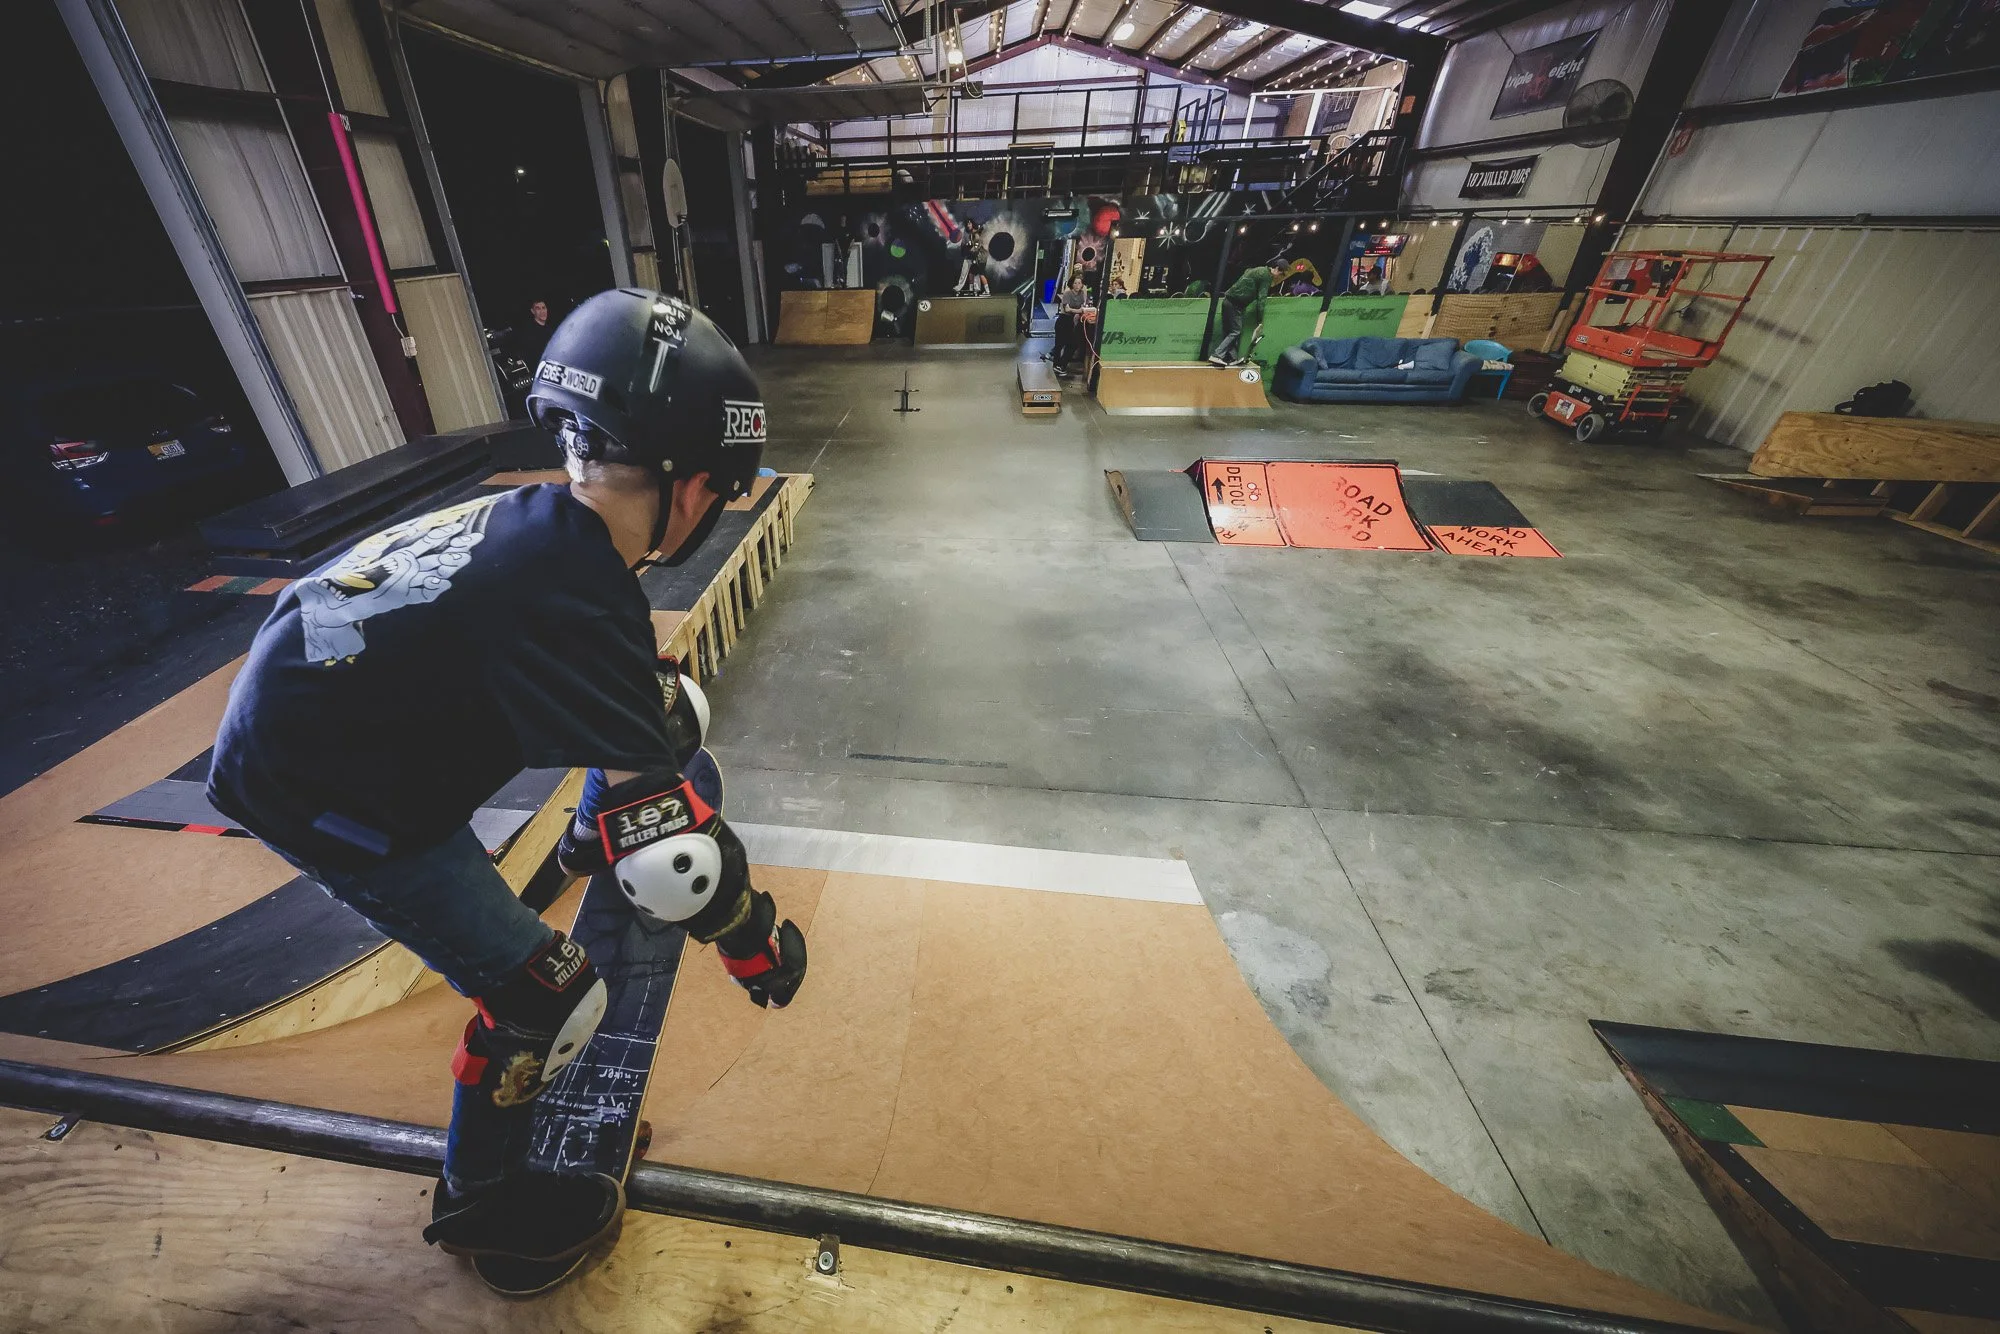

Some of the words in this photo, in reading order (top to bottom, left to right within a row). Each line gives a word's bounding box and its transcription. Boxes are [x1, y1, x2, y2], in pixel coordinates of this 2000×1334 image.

[1504, 71, 1534, 88] triple
[1547, 57, 1585, 78] eight
[1481, 170, 1509, 187] KILLER
[1506, 167, 1531, 185] PADS
[566, 369, 597, 394] WORLD
[618, 798, 684, 834] 187
[618, 826, 659, 848] KILLER
[659, 814, 689, 836] PADS
[545, 942, 578, 972] 18
